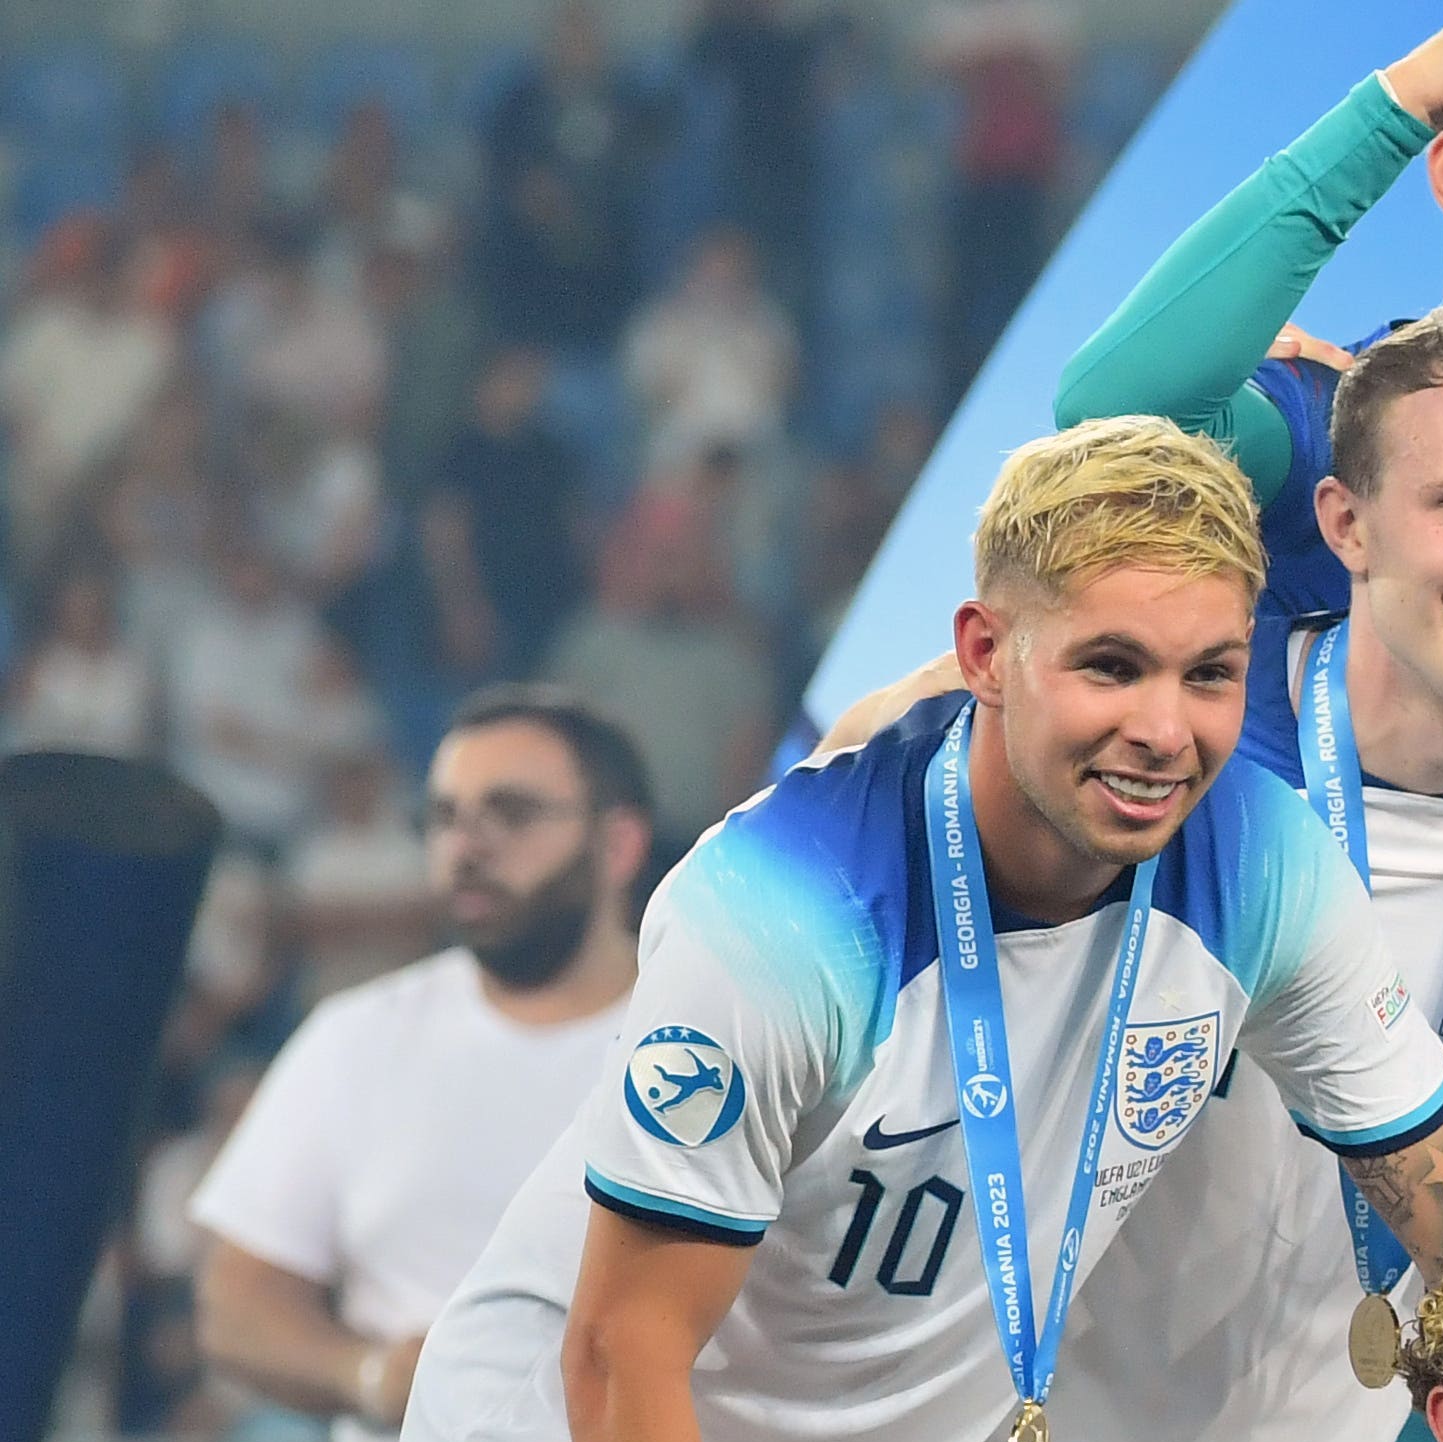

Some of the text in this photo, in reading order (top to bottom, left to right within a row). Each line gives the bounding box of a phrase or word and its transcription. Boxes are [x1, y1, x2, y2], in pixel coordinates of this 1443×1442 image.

[1313, 668, 1338, 762] ROMANIA
[943, 762, 965, 859] ROMANIA
[952, 875, 979, 970] GEORGIA
[1084, 909, 1142, 1175] GEORGIA ROMANIA 2023
[988, 1173, 1009, 1230] 2023
[1095, 1163, 1124, 1188] UEFA
[827, 1168, 966, 1297] 10
[996, 1233, 1022, 1336] ROMANIA
